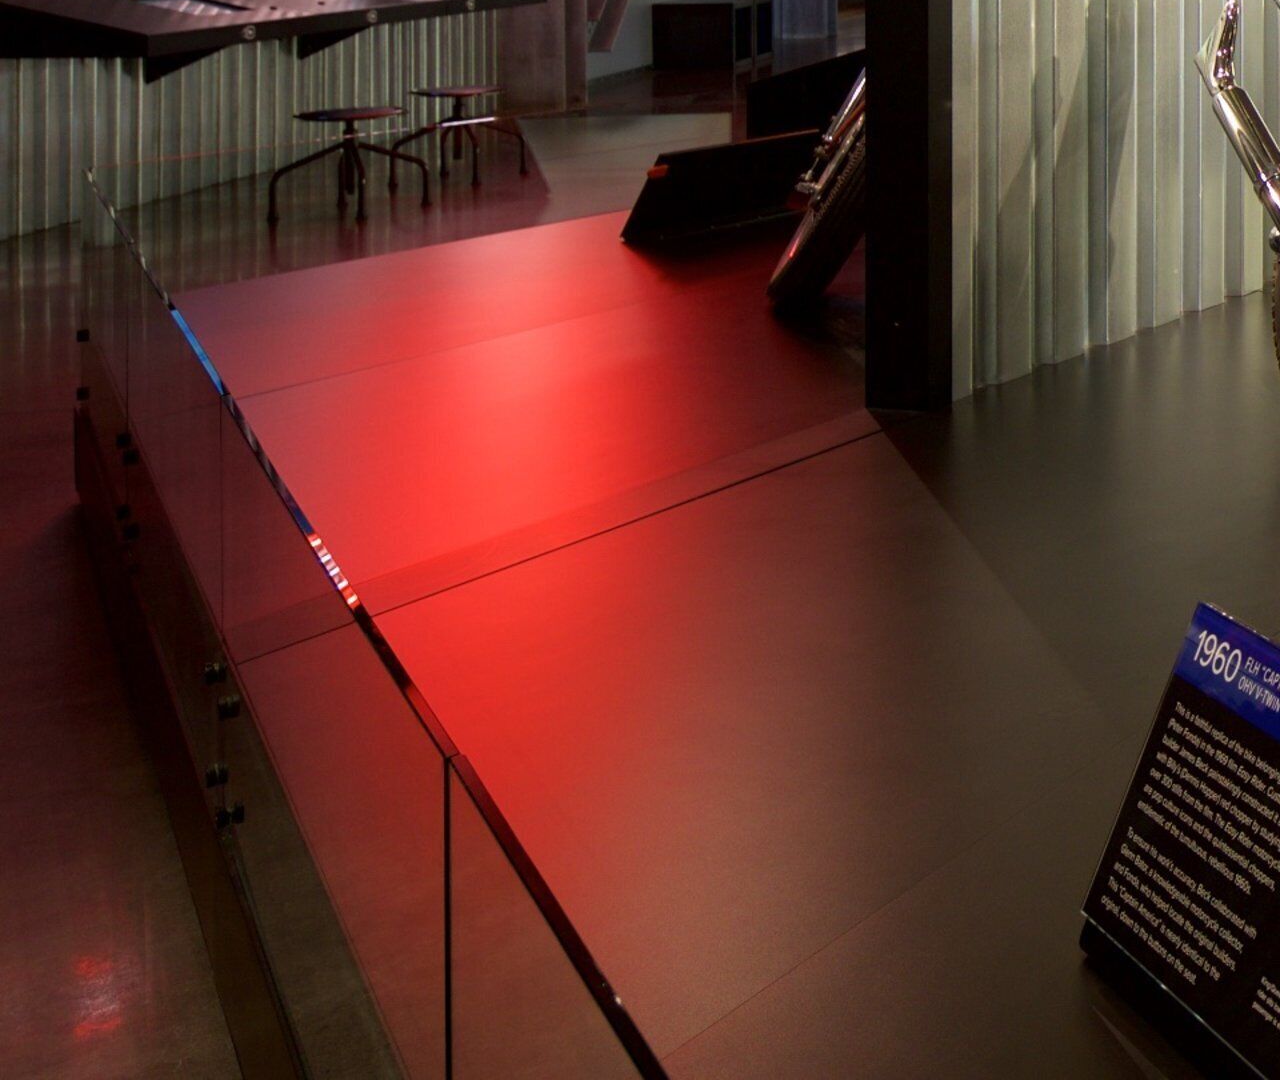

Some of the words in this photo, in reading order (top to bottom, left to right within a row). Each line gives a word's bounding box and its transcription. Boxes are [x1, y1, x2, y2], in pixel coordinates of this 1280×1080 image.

[1194, 630, 1242, 682] 1960
[1245, 657, 1260, 675] FLH
[1238, 676, 1257, 695] OHV
